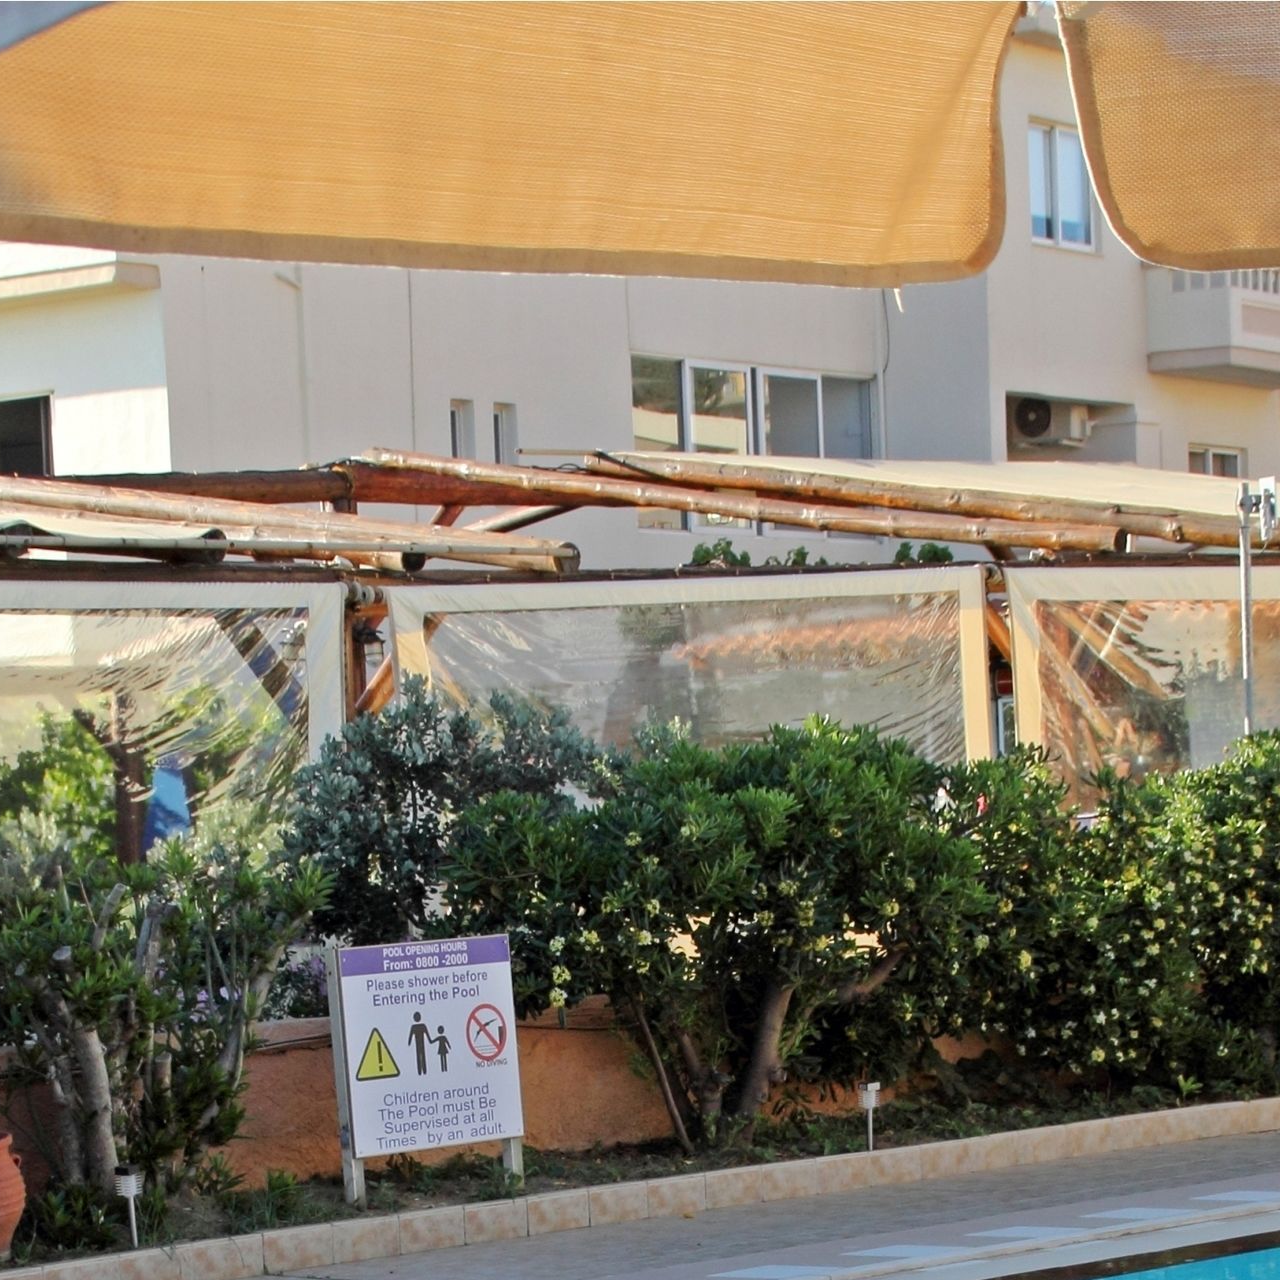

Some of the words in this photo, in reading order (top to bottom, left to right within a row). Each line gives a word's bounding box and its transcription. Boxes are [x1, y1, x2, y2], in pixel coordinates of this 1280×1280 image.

[383, 947, 404, 957] POOL
[406, 944, 440, 956] OPENING
[440, 940, 468, 952] HOURS
[384, 960, 413, 971] From:
[416, 956, 439, 968] 0800
[366, 978, 404, 992] Please
[408, 974, 449, 988] shower
[452, 970, 488, 983] before
[373, 991, 425, 1006] Entering
[429, 988, 448, 1001] the
[452, 985, 479, 998] Pool
[383, 1091, 439, 1106] Children
[444, 1082, 489, 1099] around
[378, 1108, 404, 1121] The
[408, 1103, 438, 1118] Pool
[443, 1100, 475, 1114] must
[478, 1097, 496, 1109] Be
[384, 1116, 459, 1134] Supervised
[464, 1114, 476, 1124] at
[480, 1109, 494, 1122] all
[376, 1136, 417, 1150] Times
[428, 1132, 443, 1145] by
[448, 1130, 464, 1140] an
[470, 1123, 506, 1138] adult.
